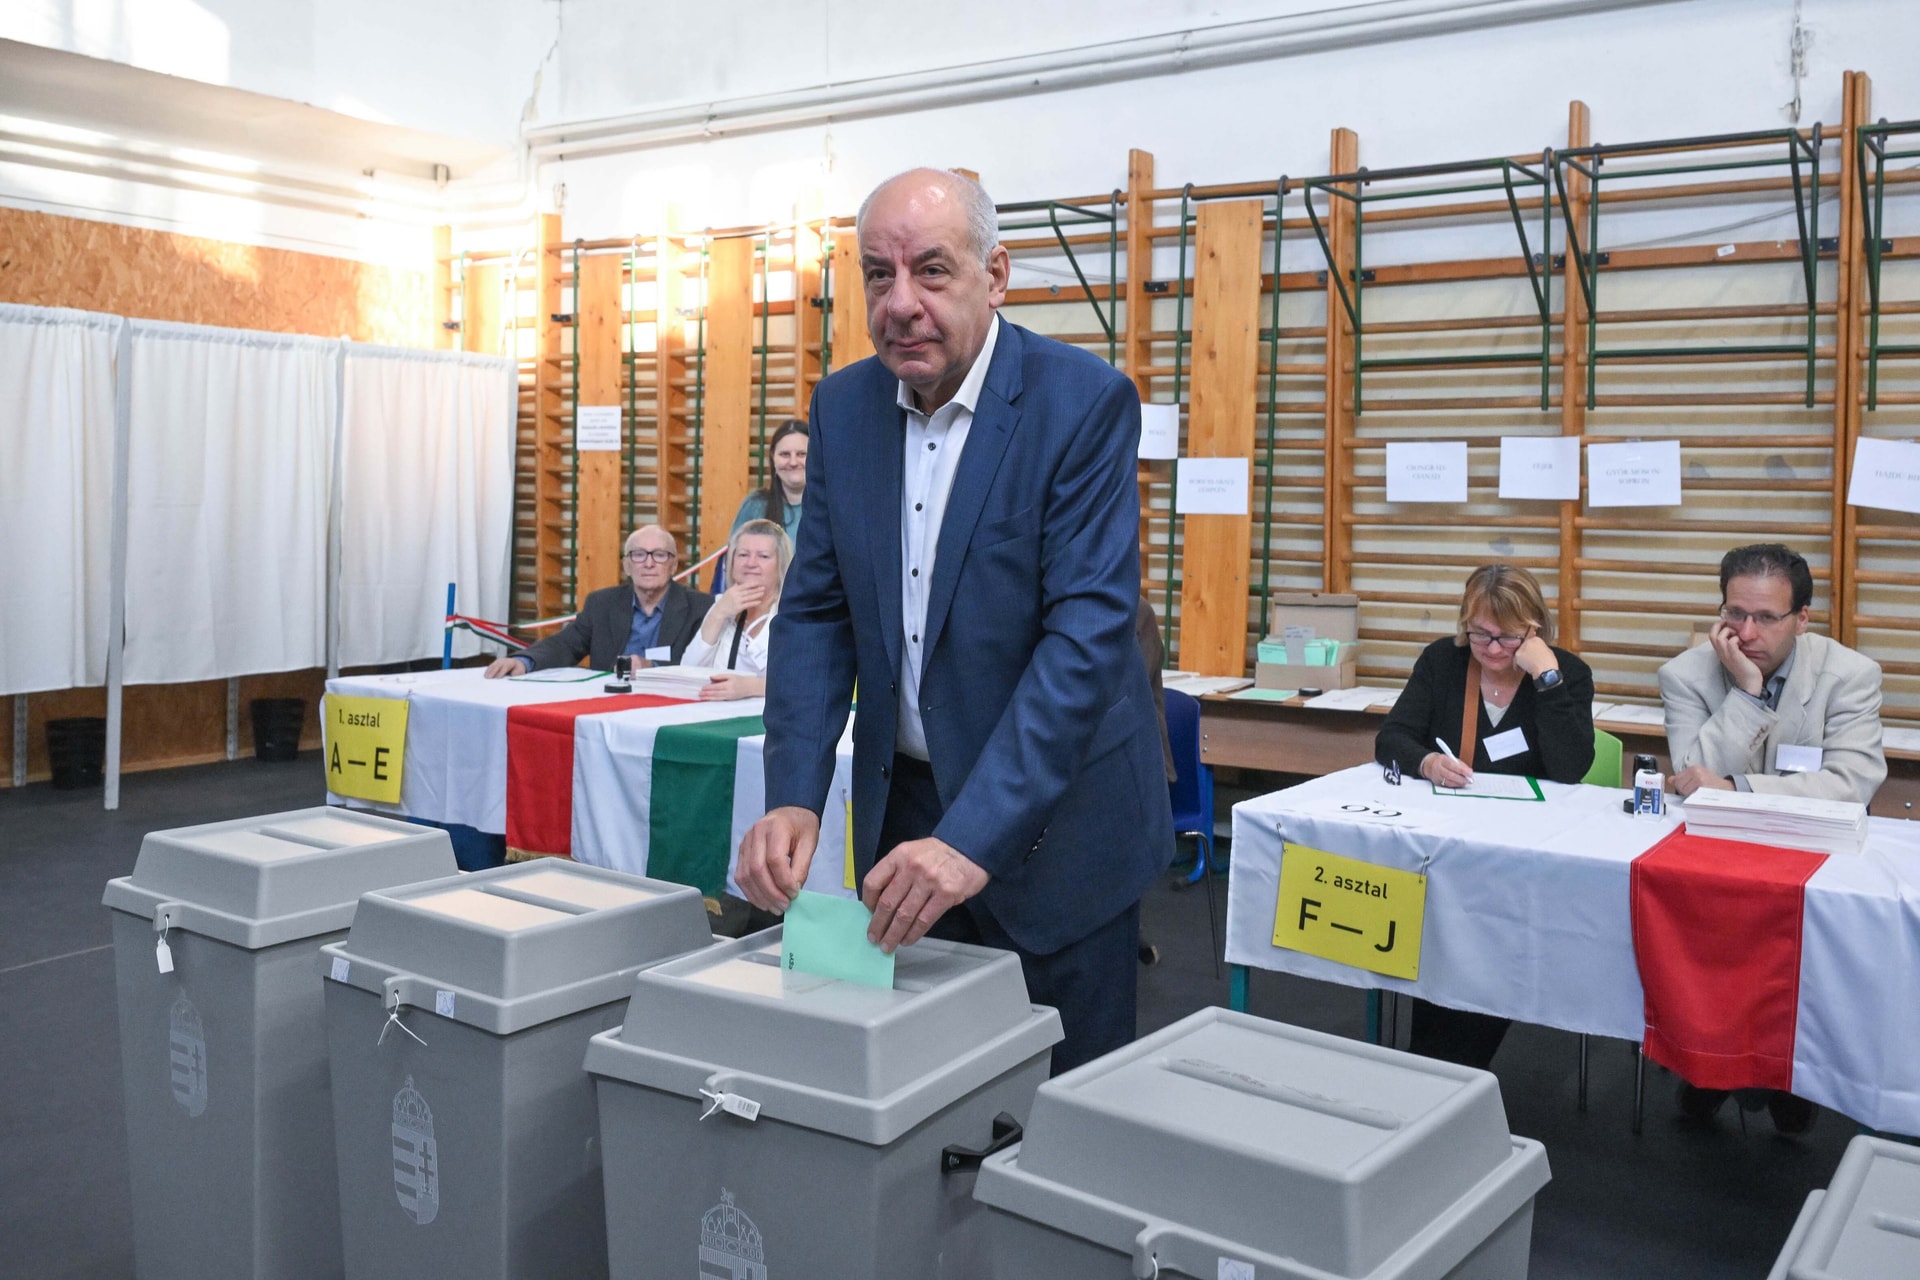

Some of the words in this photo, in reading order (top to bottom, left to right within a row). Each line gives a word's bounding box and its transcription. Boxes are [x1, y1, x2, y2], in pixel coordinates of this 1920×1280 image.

[338, 708, 345, 724] 1.
[347, 712, 380, 728] asztal
[1314, 866, 1327, 884] 2.
[1333, 875, 1388, 899] asztal
